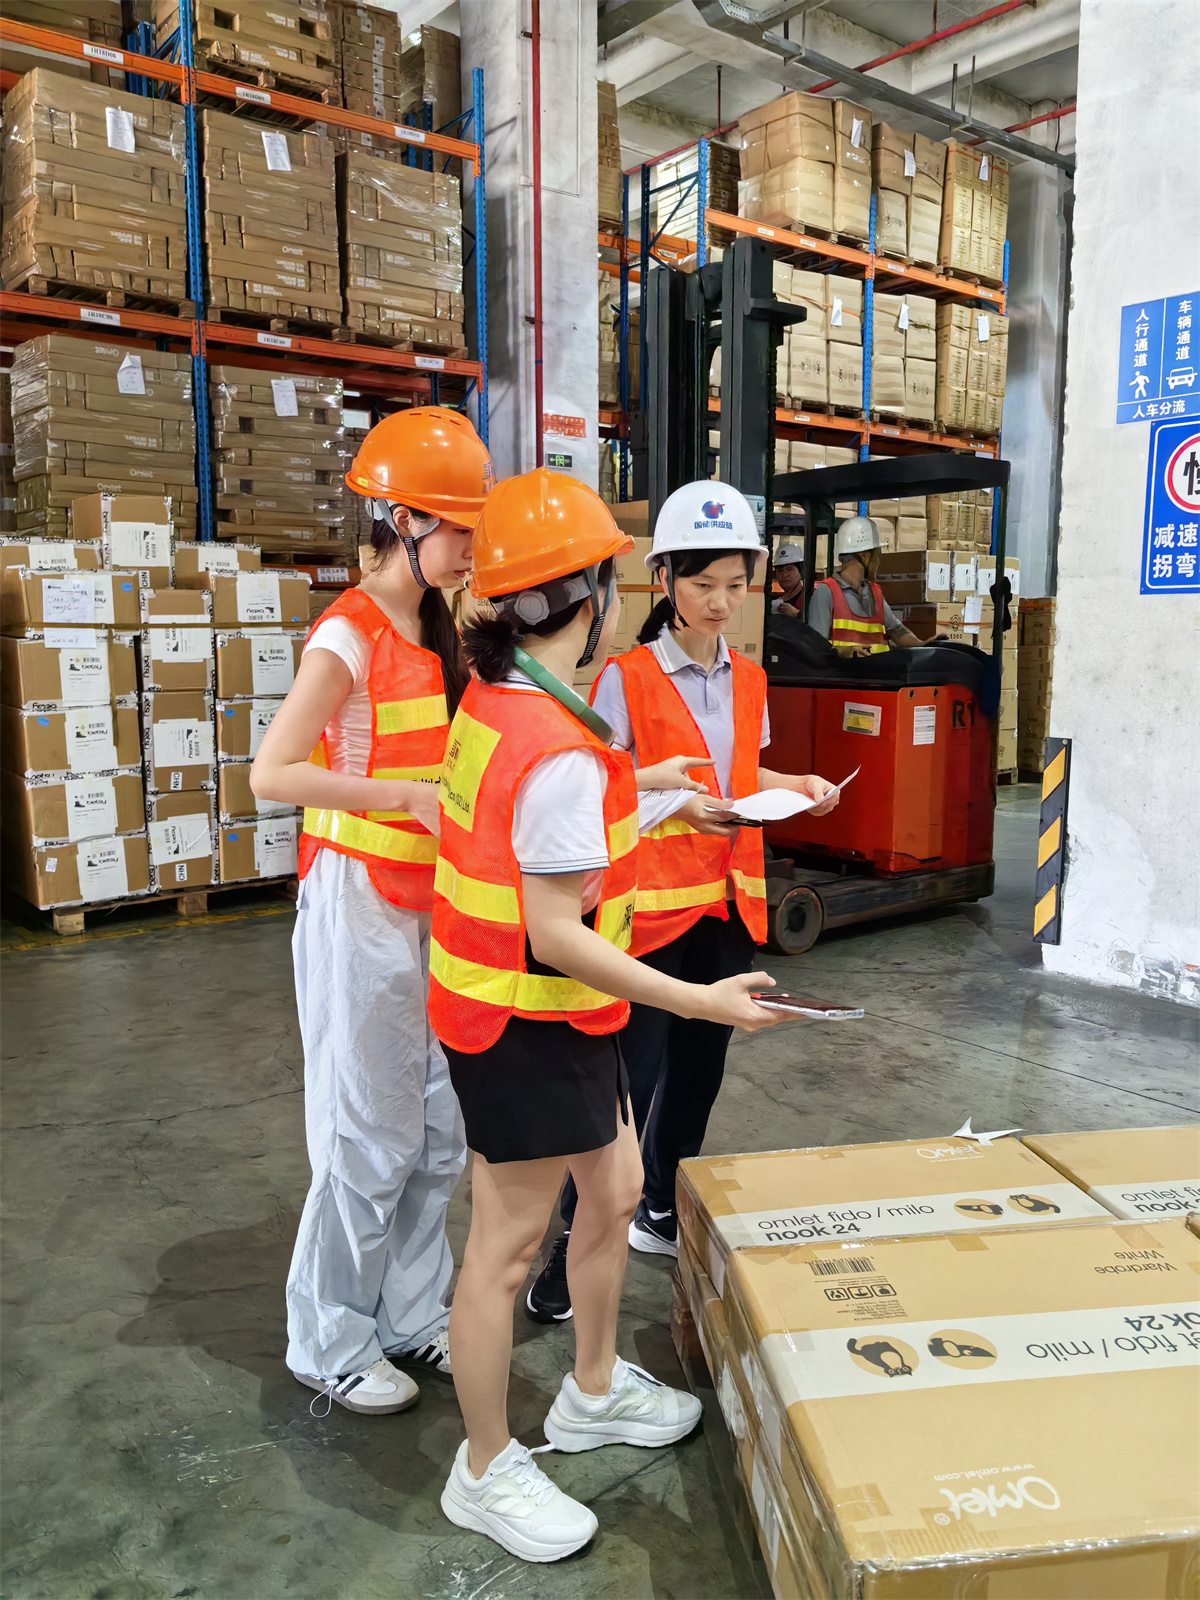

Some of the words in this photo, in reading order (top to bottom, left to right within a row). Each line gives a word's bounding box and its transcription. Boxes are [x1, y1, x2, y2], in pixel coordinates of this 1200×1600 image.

[1133, 308, 1150, 368] 人行通道
[1175, 300, 1192, 361] 车辆通道
[1132, 399, 1186, 420] 人车分流
[1153, 522, 1199, 549] 减速
[172, 772, 180, 788] CHN
[916, 1144, 981, 1159] Omlet
[1121, 1188, 1185, 1202] omlet
[1183, 1186, 1200, 1197] fi
[1134, 1199, 1198, 1213] nook
[758, 1213, 824, 1230] omlet
[827, 1209, 871, 1223] fido
[877, 1207, 881, 1218] /
[886, 1203, 935, 1217] milo
[765, 1224, 832, 1242] nook
[832, 1222, 861, 1234] 24
[1114, 1249, 1165, 1261] White
[1094, 1262, 1178, 1274] Wardrobe
[1123, 1314, 1164, 1332] 24
[1026, 1340, 1095, 1362] milo
[1114, 1334, 1178, 1355] fido
[933, 1463, 1036, 1483] www.omlet.com
[939, 1475, 1061, 1521] Omlet
